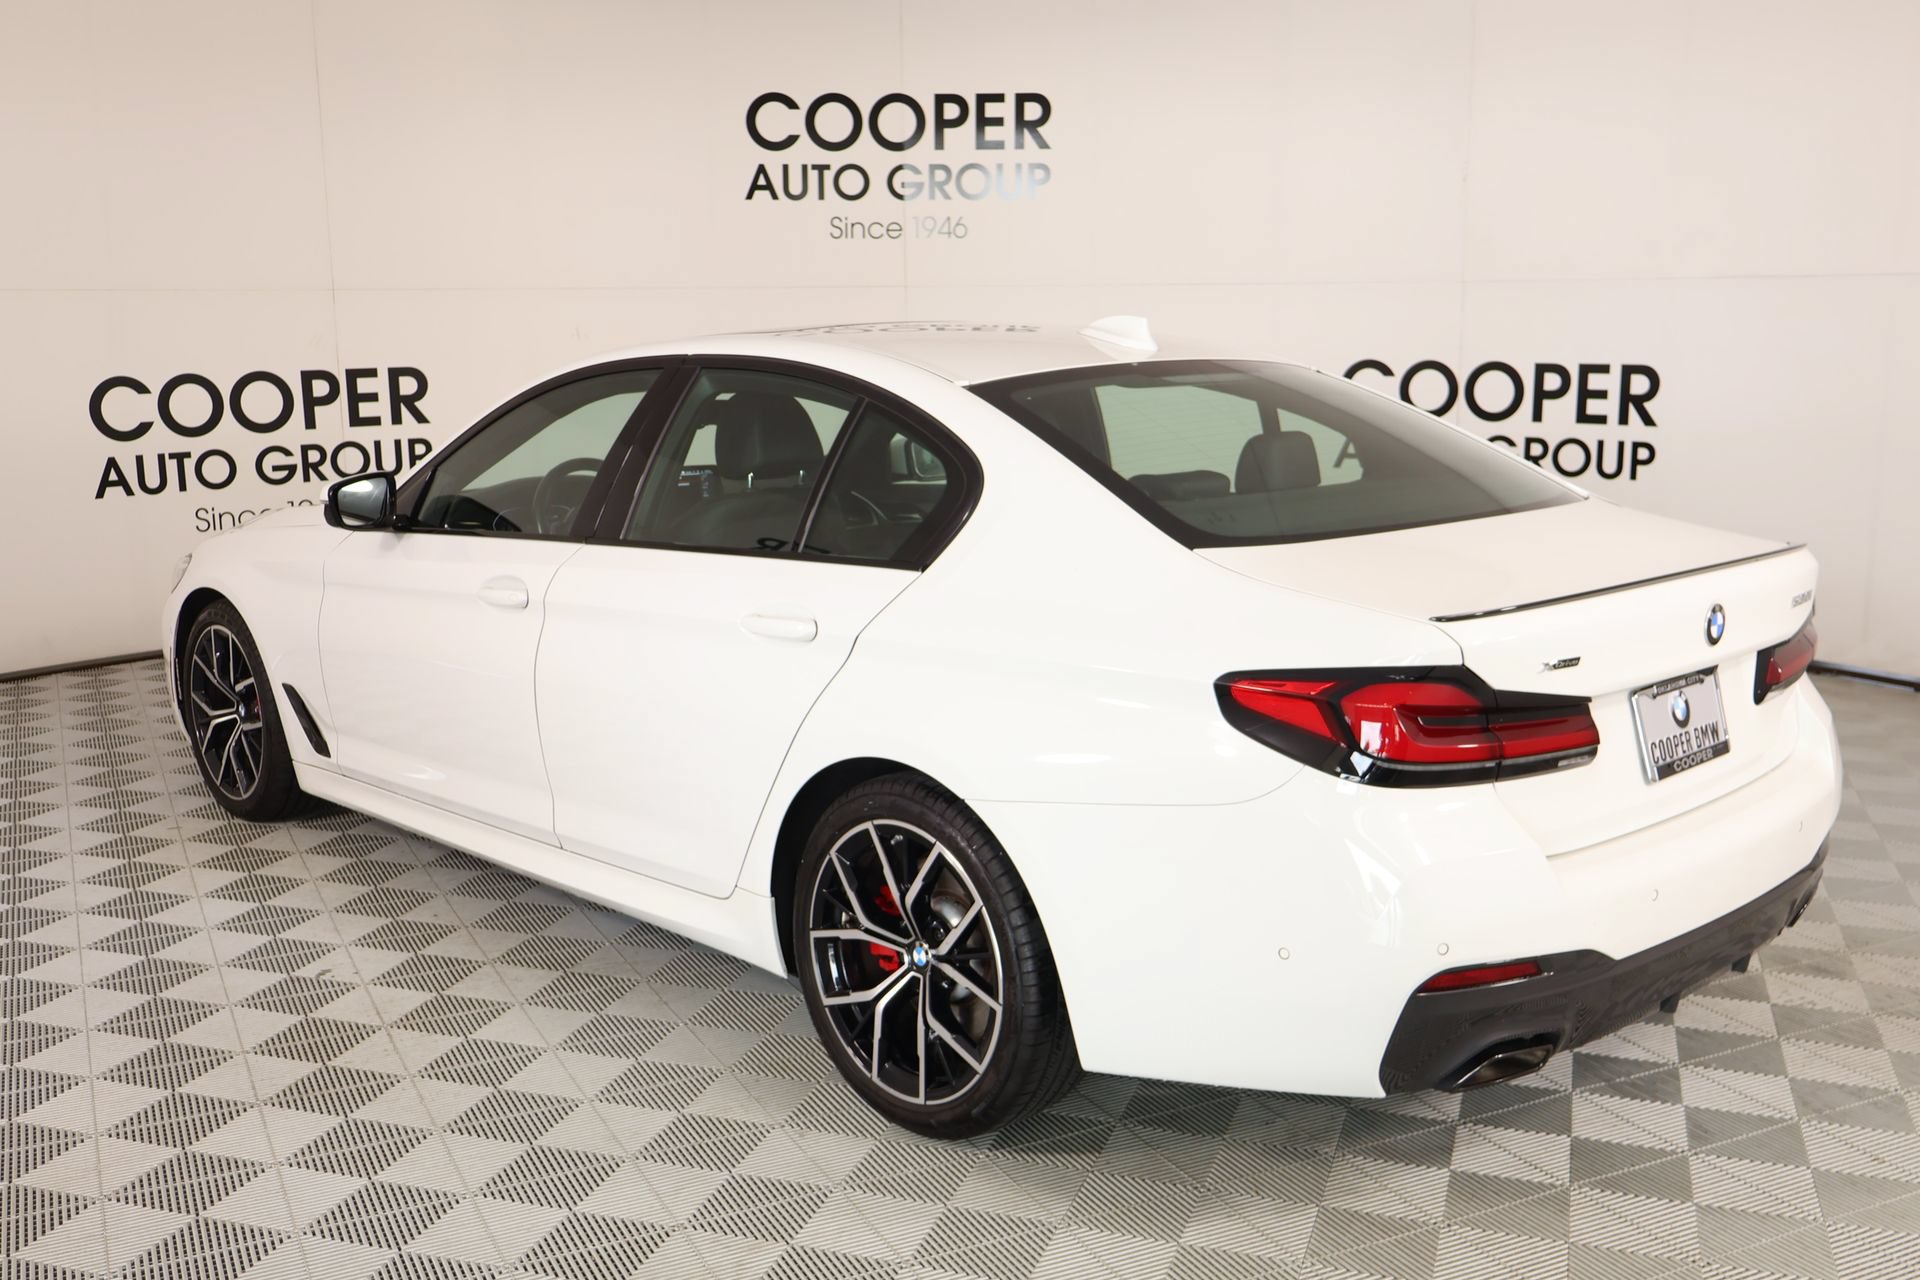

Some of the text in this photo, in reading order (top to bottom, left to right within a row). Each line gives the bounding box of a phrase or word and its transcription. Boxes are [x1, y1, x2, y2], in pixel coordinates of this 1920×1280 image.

[746, 92, 1052, 152] COOPER
[745, 163, 1051, 201] AUTO GROUP
[829, 216, 968, 239] Since 1946
[89, 367, 431, 442] COOPER
[95, 438, 433, 499] AUTO GROUP
[1650, 721, 1720, 765] COOPER BMW
[1673, 748, 1713, 771] COOPER
